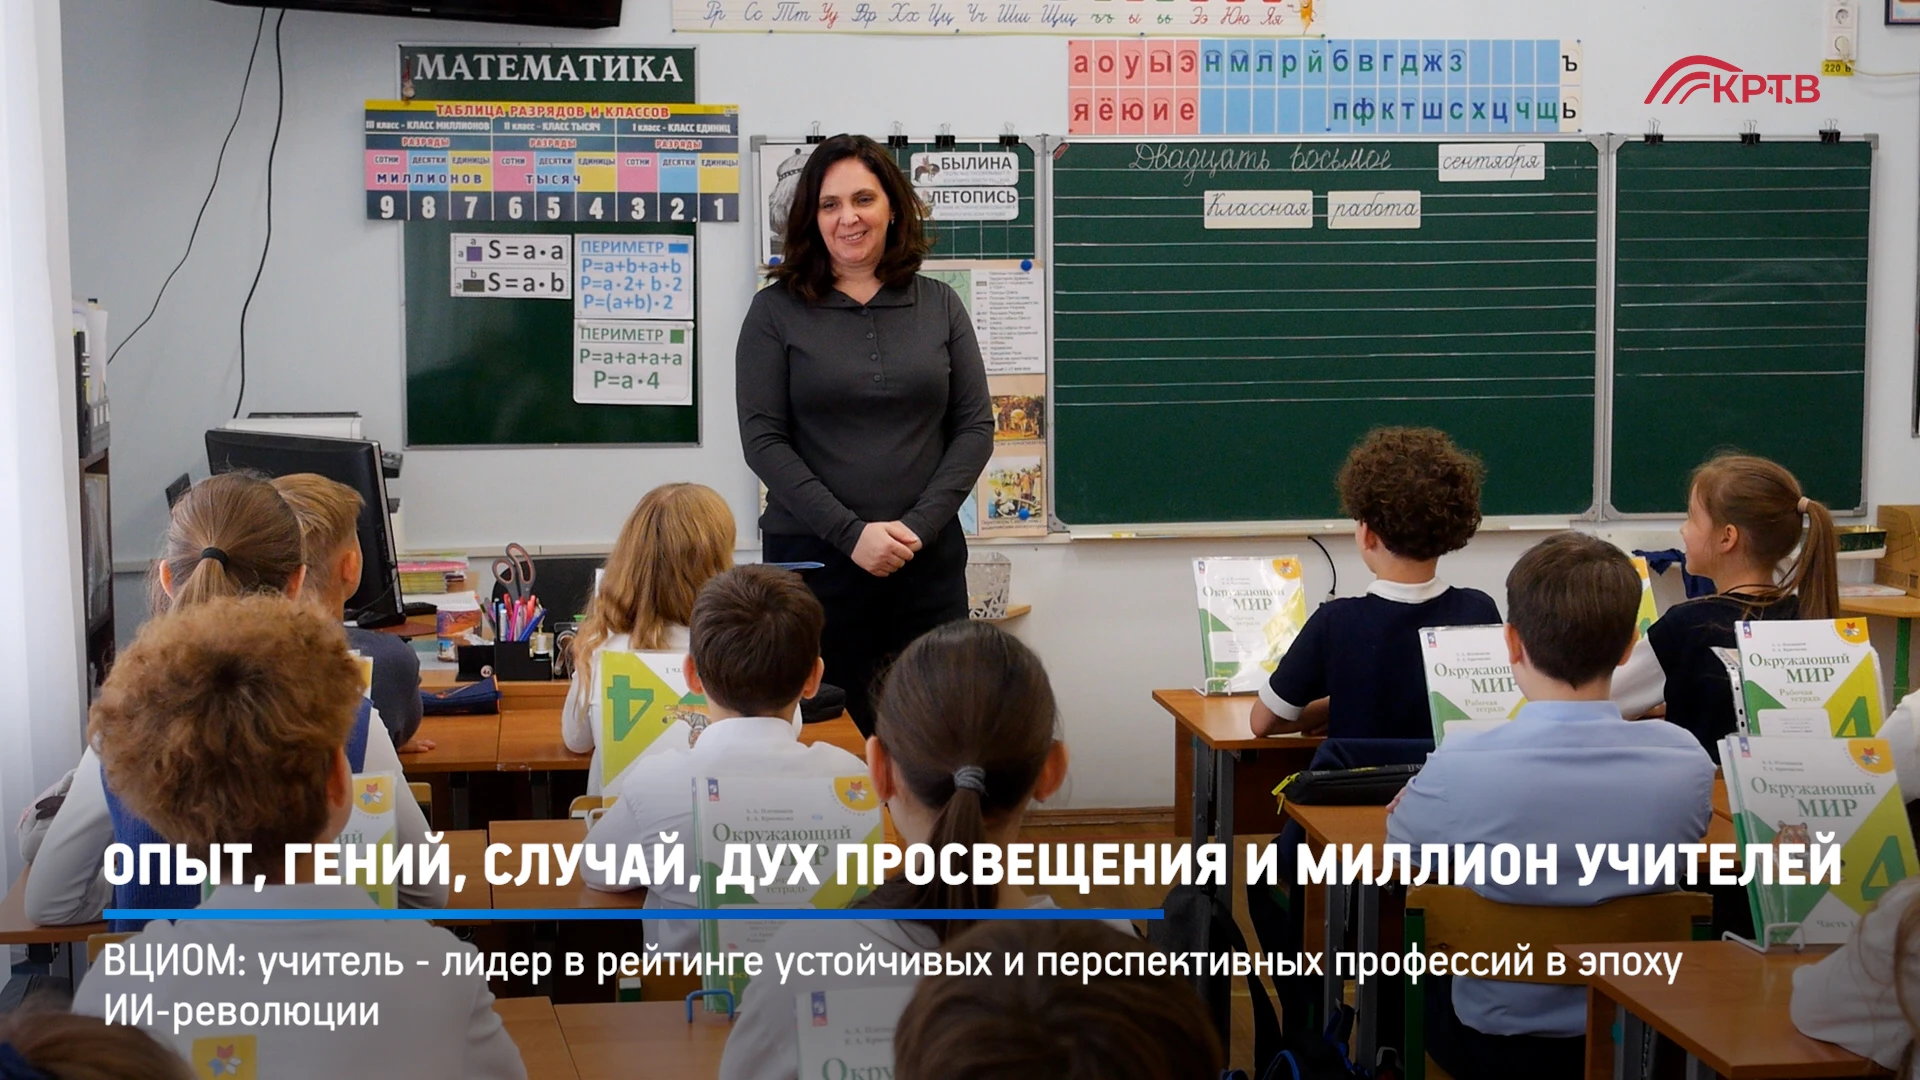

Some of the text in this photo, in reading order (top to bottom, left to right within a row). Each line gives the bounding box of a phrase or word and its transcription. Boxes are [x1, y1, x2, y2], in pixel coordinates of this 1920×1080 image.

[415, 53, 683, 82] МАТЕМАТИКА
[1824, 63, 1841, 72] 220
[436, 104, 669, 118] ТАБЛИЦА РАЗРЯДОВ И КЛАССОВ
[407, 121, 435, 129] КЛАСС
[436, 121, 491, 130] МИЛЛИОНОВ
[542, 122, 569, 131] КЛАСС
[571, 122, 600, 131] ТЫСЯЧ
[638, 124, 661, 132] класс
[668, 123, 695, 132] КЛАСС
[696, 124, 731, 133] ЕДИНИЦ
[402, 138, 450, 147] РАЗРЯДЫ
[529, 139, 577, 148] РАЗРЯДЫ
[655, 140, 702, 149] РАЗРЯДЫ
[578, 158, 616, 166] ЕДИНИЦЫ
[941, 157, 1013, 170] БЫЛИНА
[1128, 143, 1392, 187] Двадцать восьмое
[1442, 144, 1540, 179] сентября
[377, 174, 482, 184] МИЛЛИОНОВ
[526, 175, 581, 185] ТЫСЯЧ
[929, 190, 1017, 204] ЛЕТОПИСЬ
[380, 196, 724, 220] 9 8 7 6 5 4 3 2 1
[1207, 192, 1418, 227] Классная работа
[581, 241, 664, 253] ПЕРИМЕТР
[580, 327, 664, 341] ПЕРИМЕТР
[1233, 598, 1272, 611] МИР
[1749, 653, 1850, 668] Окружающий
[1786, 668, 1835, 684] МИР
[1779, 688, 1813, 697] Рабочая
[1751, 776, 1876, 798] Окружающий
[1797, 799, 1858, 817] МИР
[713, 823, 852, 843] Окружающий
